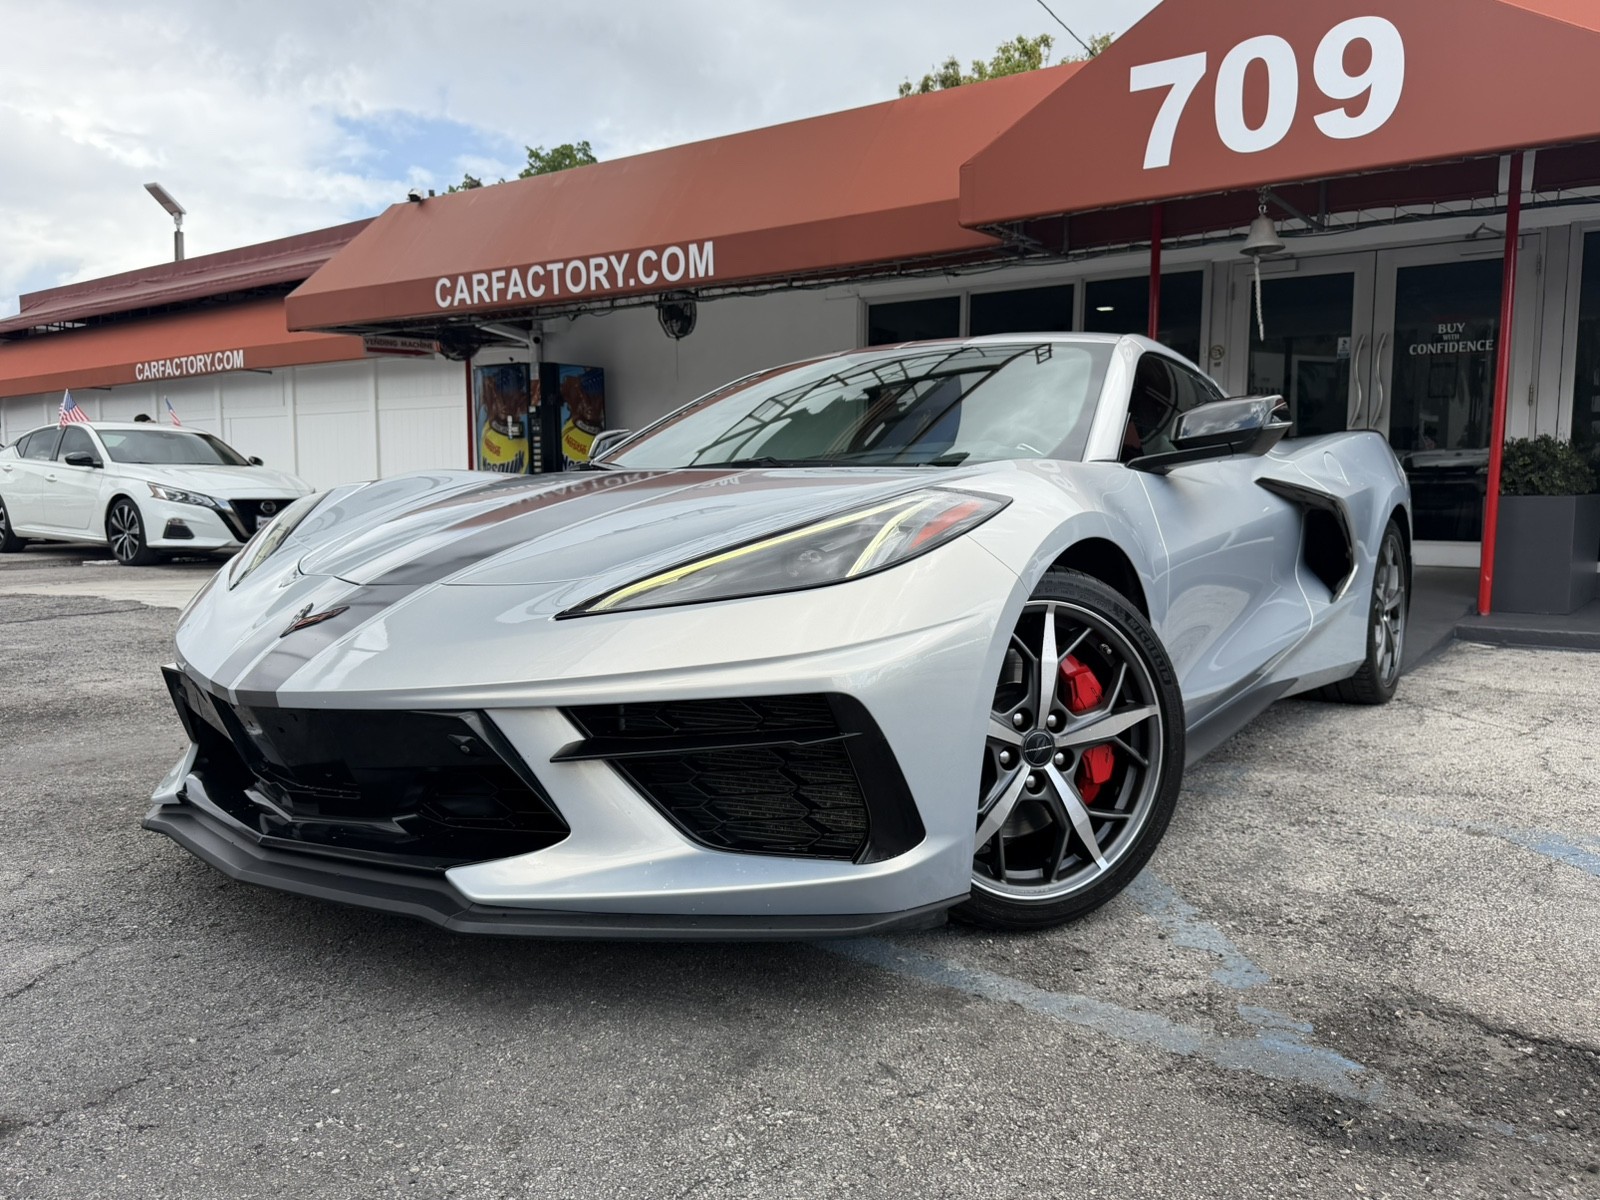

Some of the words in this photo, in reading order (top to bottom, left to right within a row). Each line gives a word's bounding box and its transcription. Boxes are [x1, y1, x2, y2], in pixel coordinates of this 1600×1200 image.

[1130, 16, 1405, 169] 709
[435, 240, 715, 308] CARFACTORY.COM
[1438, 322, 1465, 334] BUY
[1409, 340, 1494, 355] CONFIDENCE
[135, 349, 244, 380] CARFACTORY.COM
